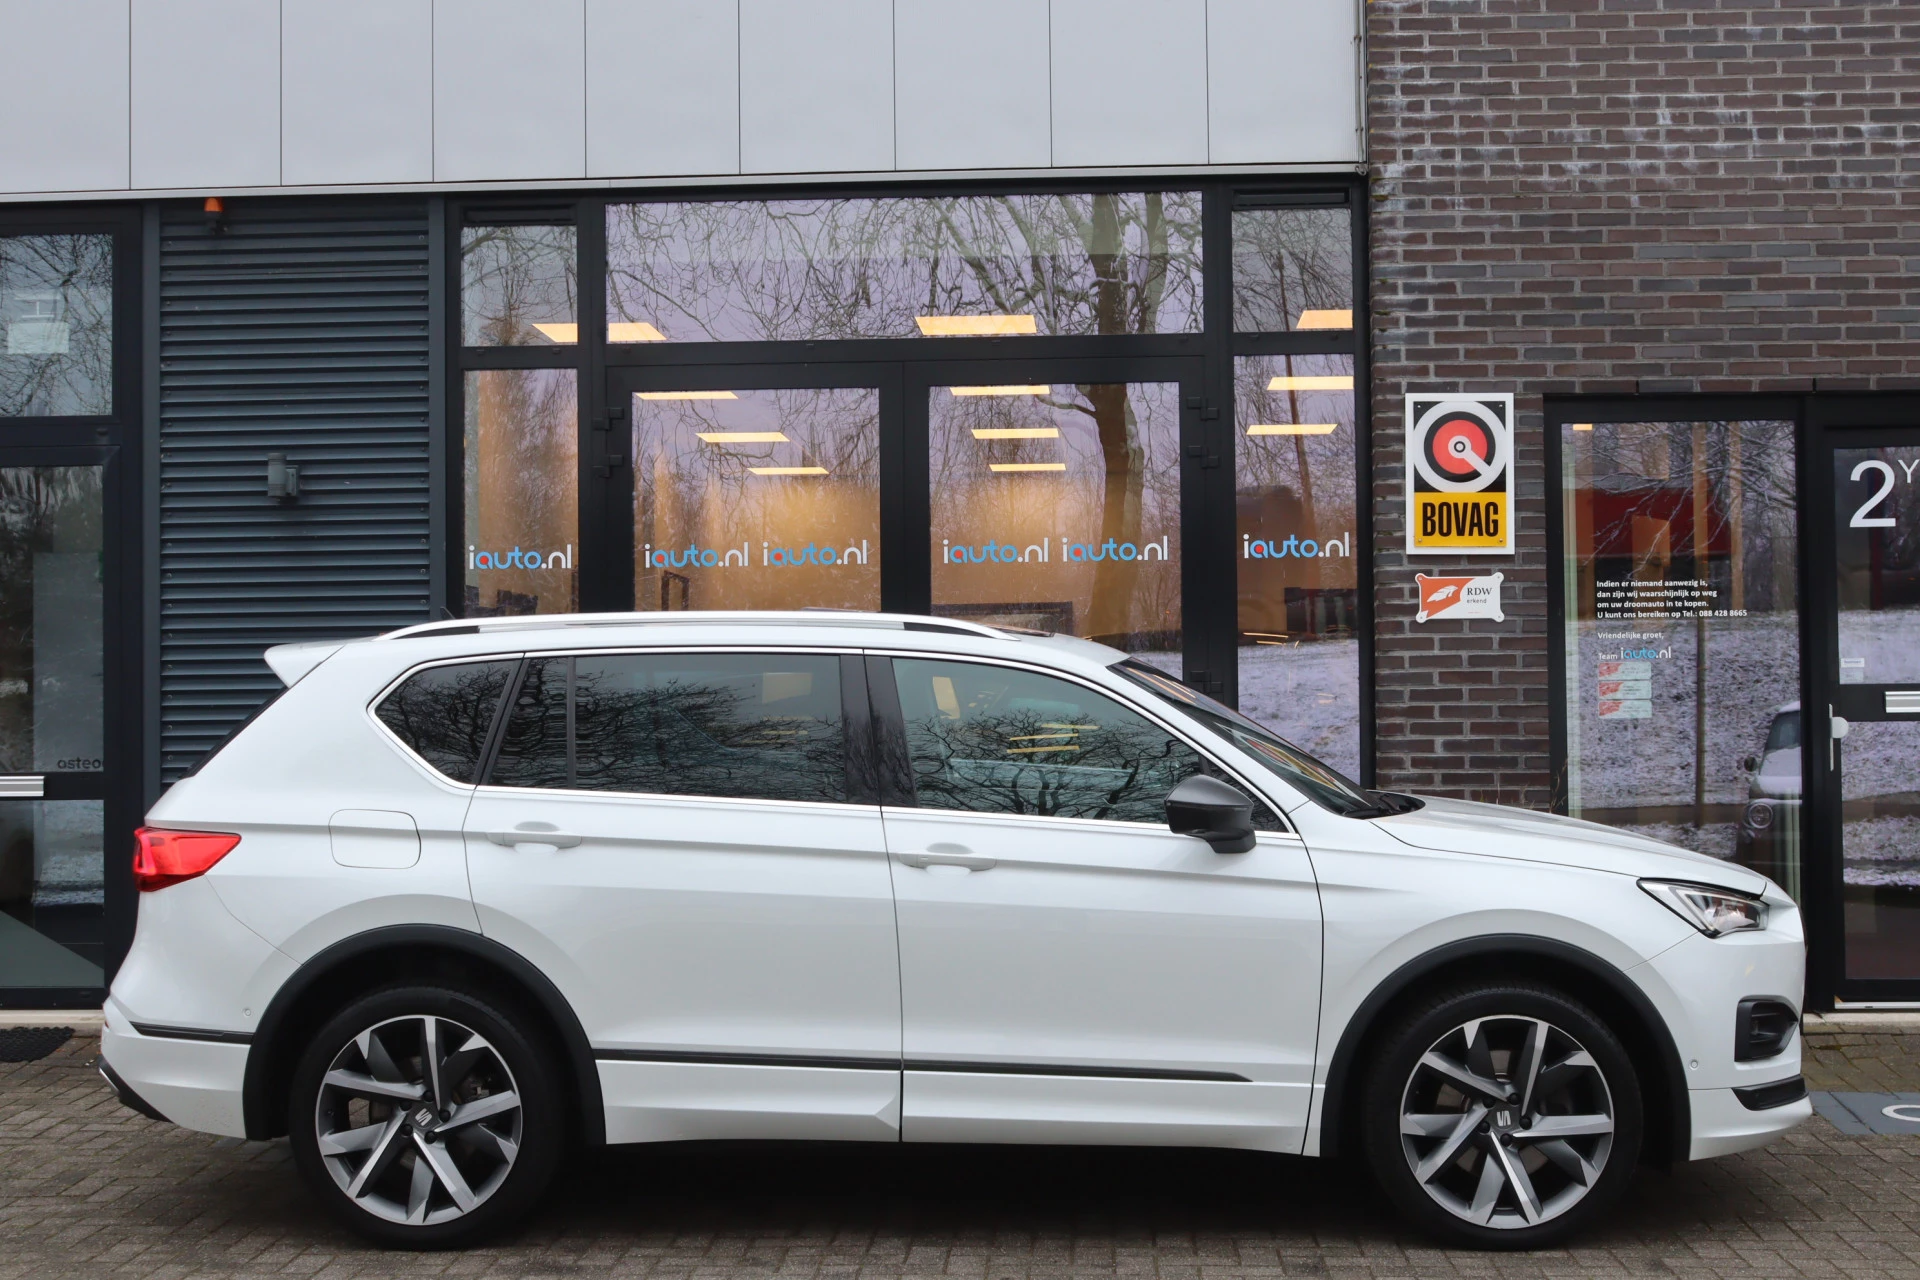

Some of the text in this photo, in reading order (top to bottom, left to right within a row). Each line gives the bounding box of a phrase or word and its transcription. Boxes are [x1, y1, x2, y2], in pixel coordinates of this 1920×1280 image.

[1422, 501, 1499, 538] BOVAG
[943, 535, 1168, 564] iauto.nl iauto.nl
[1243, 532, 1350, 559] iauto.nl
[468, 544, 572, 570] iauto.nl
[645, 539, 868, 568] iauto.nl iauto.nl
[1596, 580, 1619, 588] Indien
[1664, 579, 1698, 588] aanwezig
[1699, 579, 1708, 587] is,
[1467, 587, 1493, 596] RDW
[1612, 591, 1625, 599] zijn
[1627, 591, 1638, 599] wij
[1640, 590, 1689, 598] waarschijnlijk
[1624, 600, 1664, 608] droomauto
[1684, 600, 1709, 608] kopen.
[1598, 632, 1664, 640] Vriendelijke groet,
[1620, 646, 1672, 659] iauto.nl
[57, 757, 104, 769] osteo
